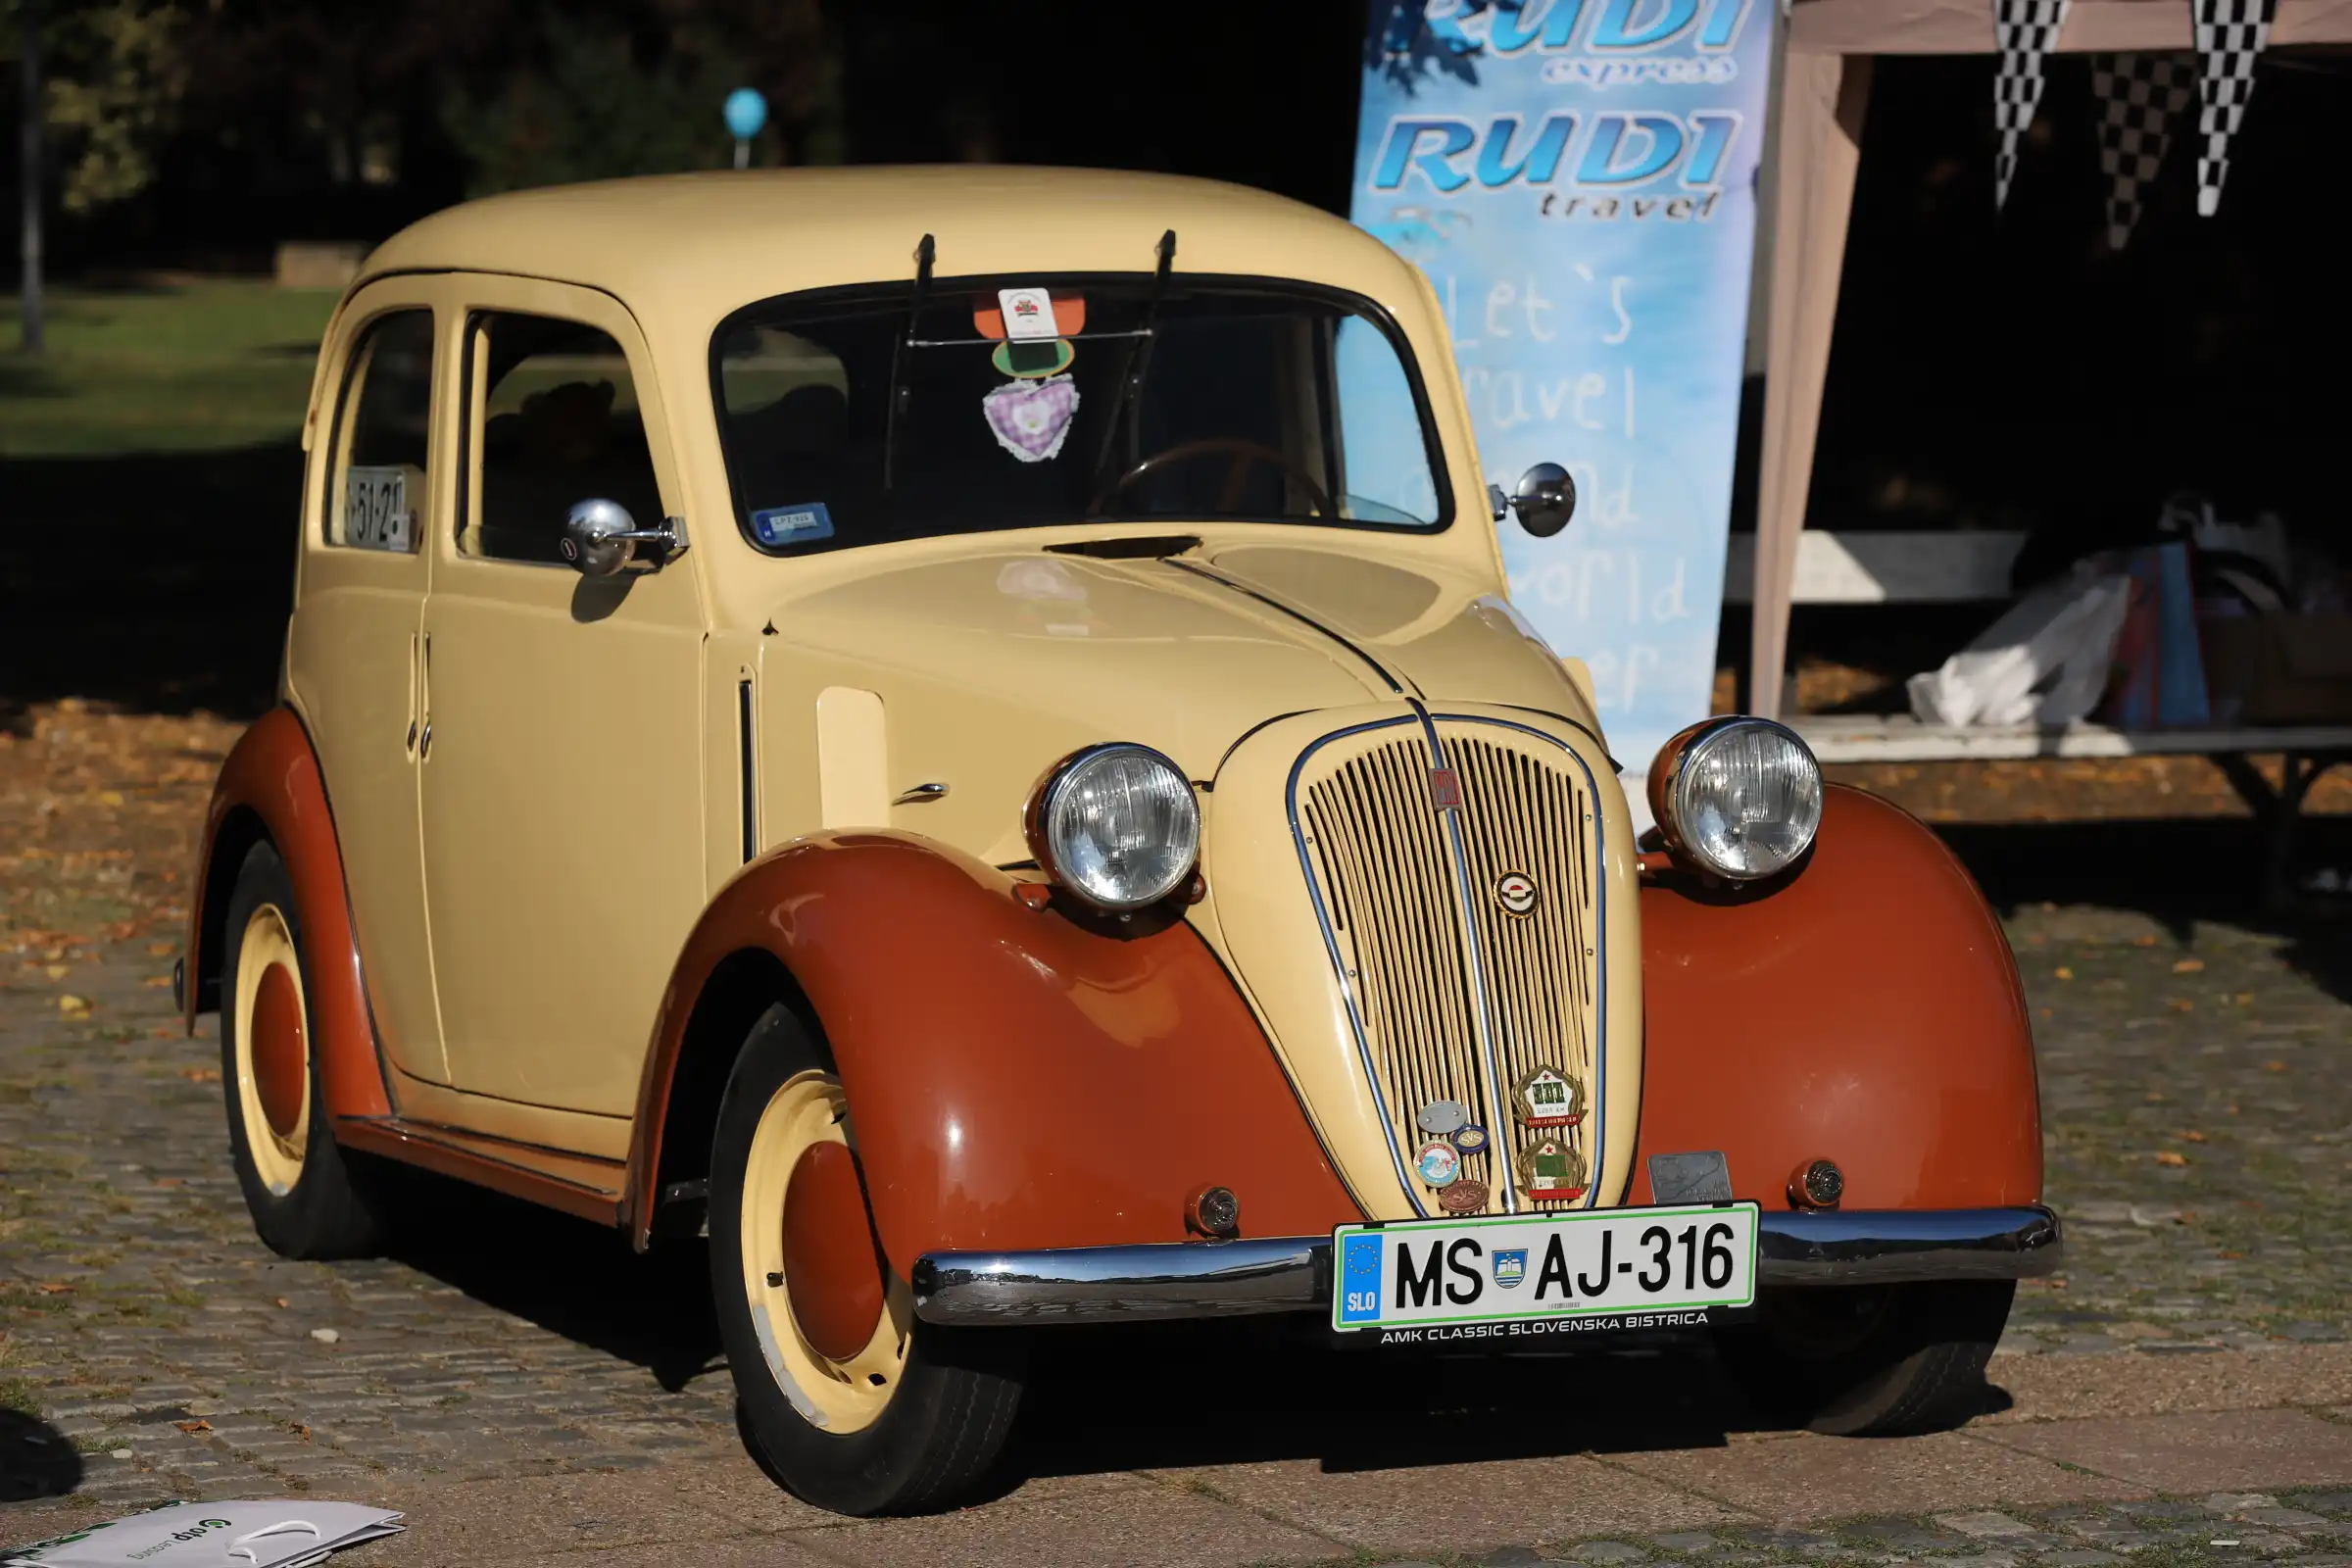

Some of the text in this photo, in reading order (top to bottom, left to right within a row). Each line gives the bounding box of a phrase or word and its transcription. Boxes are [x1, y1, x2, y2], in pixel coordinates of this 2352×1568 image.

[1371, 111, 1742, 195] RUDI
[1540, 192, 1719, 220] travel
[1464, 365, 1635, 441] ravel
[1460, 1132, 1482, 1146] SVS
[1453, 1188, 1478, 1203] SVS
[1396, 1223, 1735, 1309] MS AJ-316
[1348, 1291, 1376, 1312] SLO
[1381, 1312, 1709, 1344] AMK CLASSIC SLOVENSKA BISTRICA
[171, 1528, 208, 1542] otp
